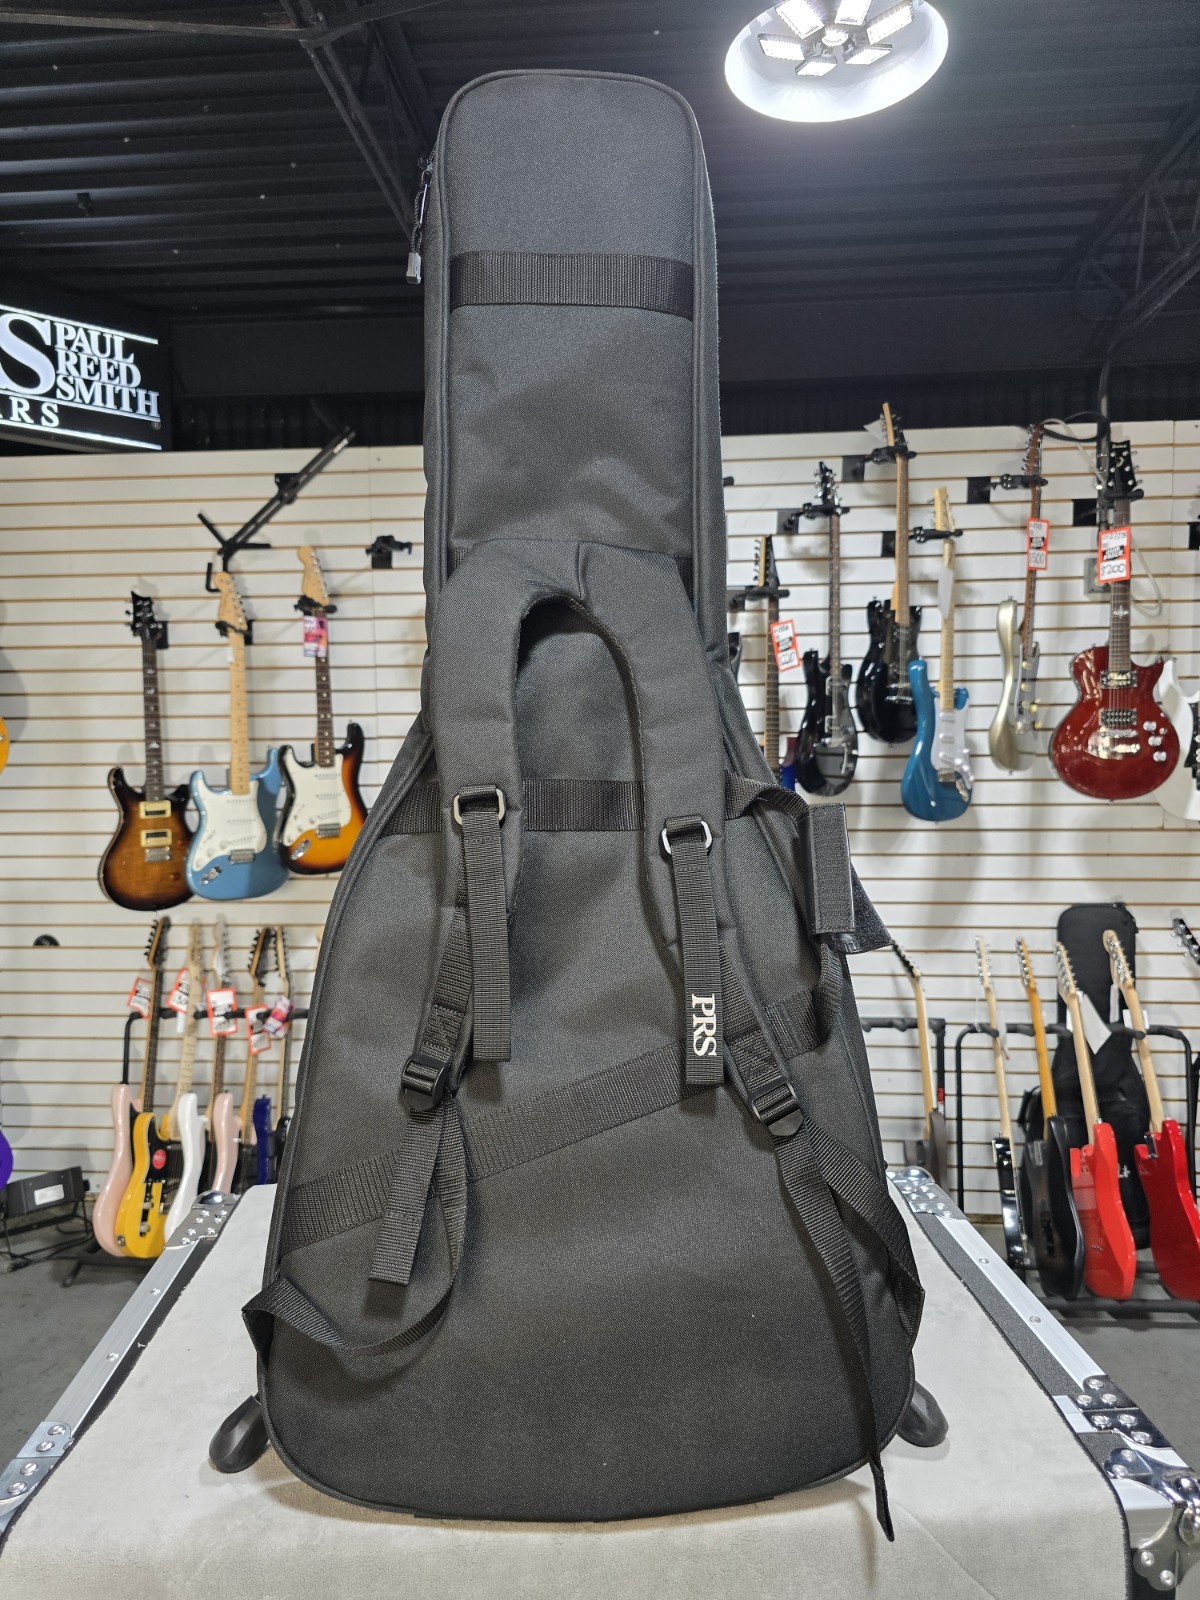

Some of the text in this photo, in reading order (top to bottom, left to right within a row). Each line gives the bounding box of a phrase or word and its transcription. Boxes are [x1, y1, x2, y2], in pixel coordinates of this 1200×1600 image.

[54, 321, 135, 364] PAUL
[55, 348, 142, 388] REED
[0, 395, 60, 428] RS
[56, 375, 161, 418] SMITH
[691, 993, 718, 1057] PRS
